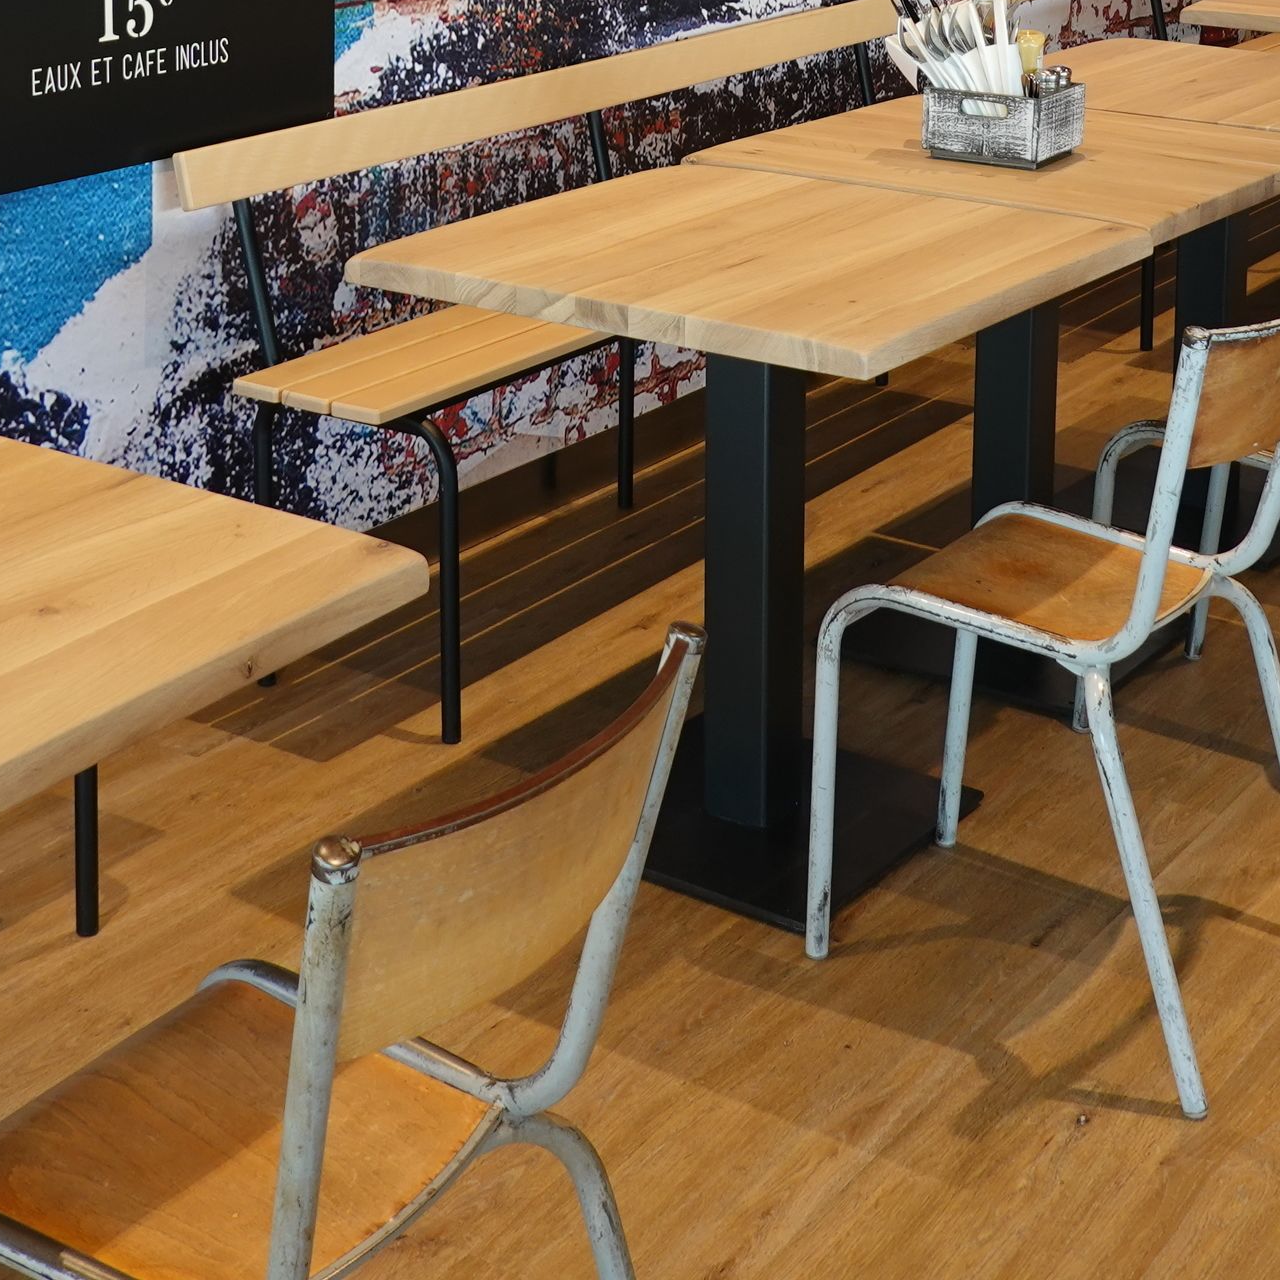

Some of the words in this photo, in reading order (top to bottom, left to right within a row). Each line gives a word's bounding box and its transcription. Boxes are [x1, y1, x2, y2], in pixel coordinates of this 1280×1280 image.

[32, 62, 81, 96] EAUX
[91, 57, 112, 86] ET
[123, 44, 166, 80] CAFE
[176, 39, 228, 72] INCLUS
